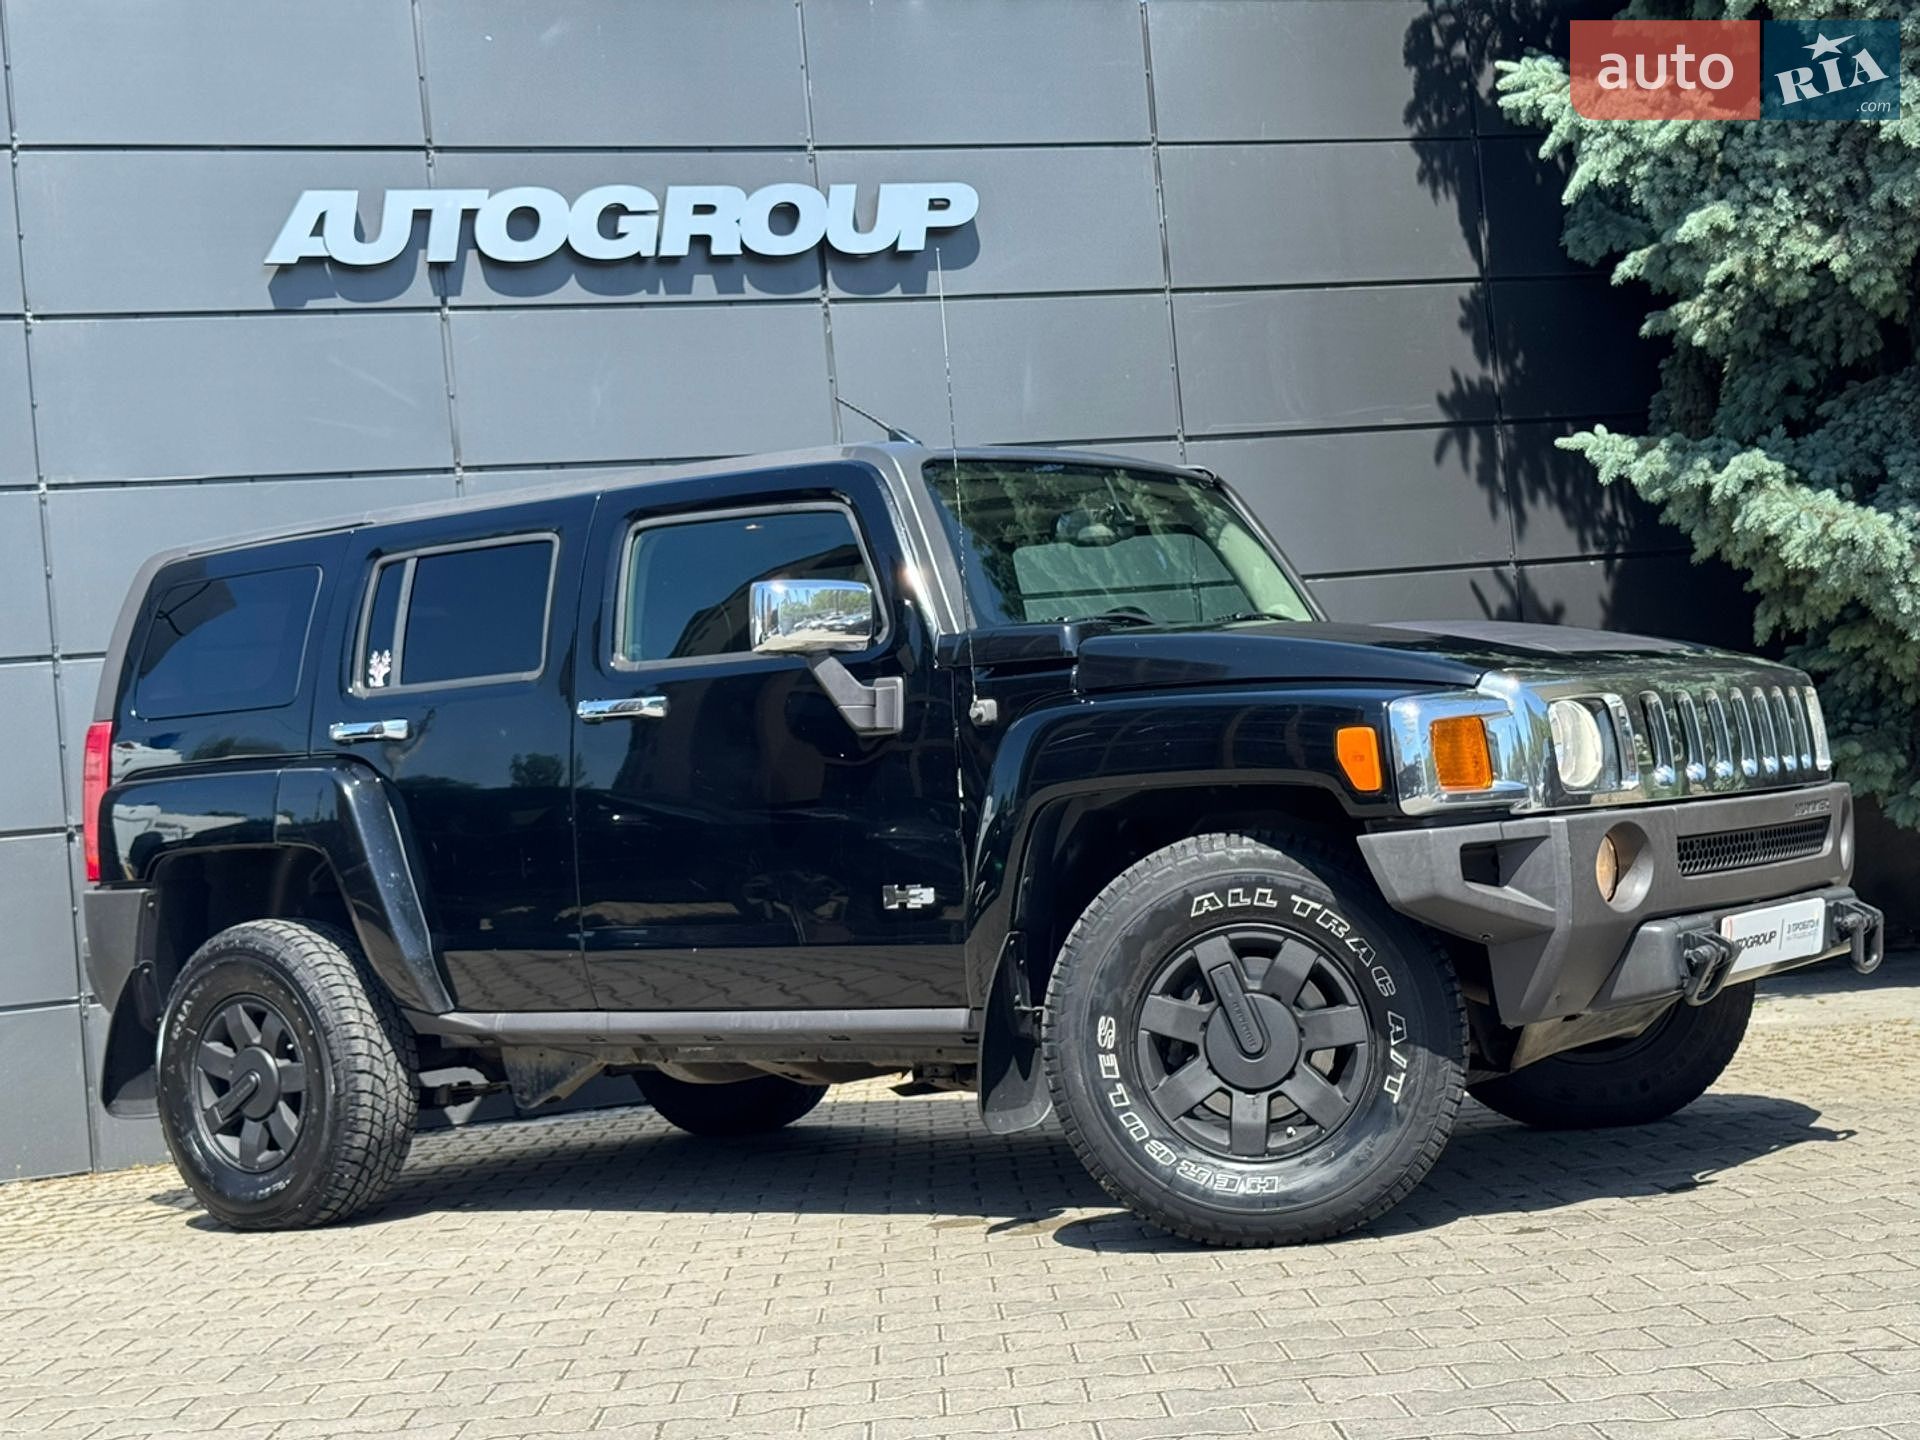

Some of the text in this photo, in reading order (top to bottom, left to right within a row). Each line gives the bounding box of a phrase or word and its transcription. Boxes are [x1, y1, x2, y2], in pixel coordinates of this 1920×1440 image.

[264, 182, 980, 266] AUTOGROUP
[883, 884, 935, 910] H3
[1190, 887, 1409, 1104] ALL TRAC A/T
[1097, 1015, 1279, 1195] HERCULES
